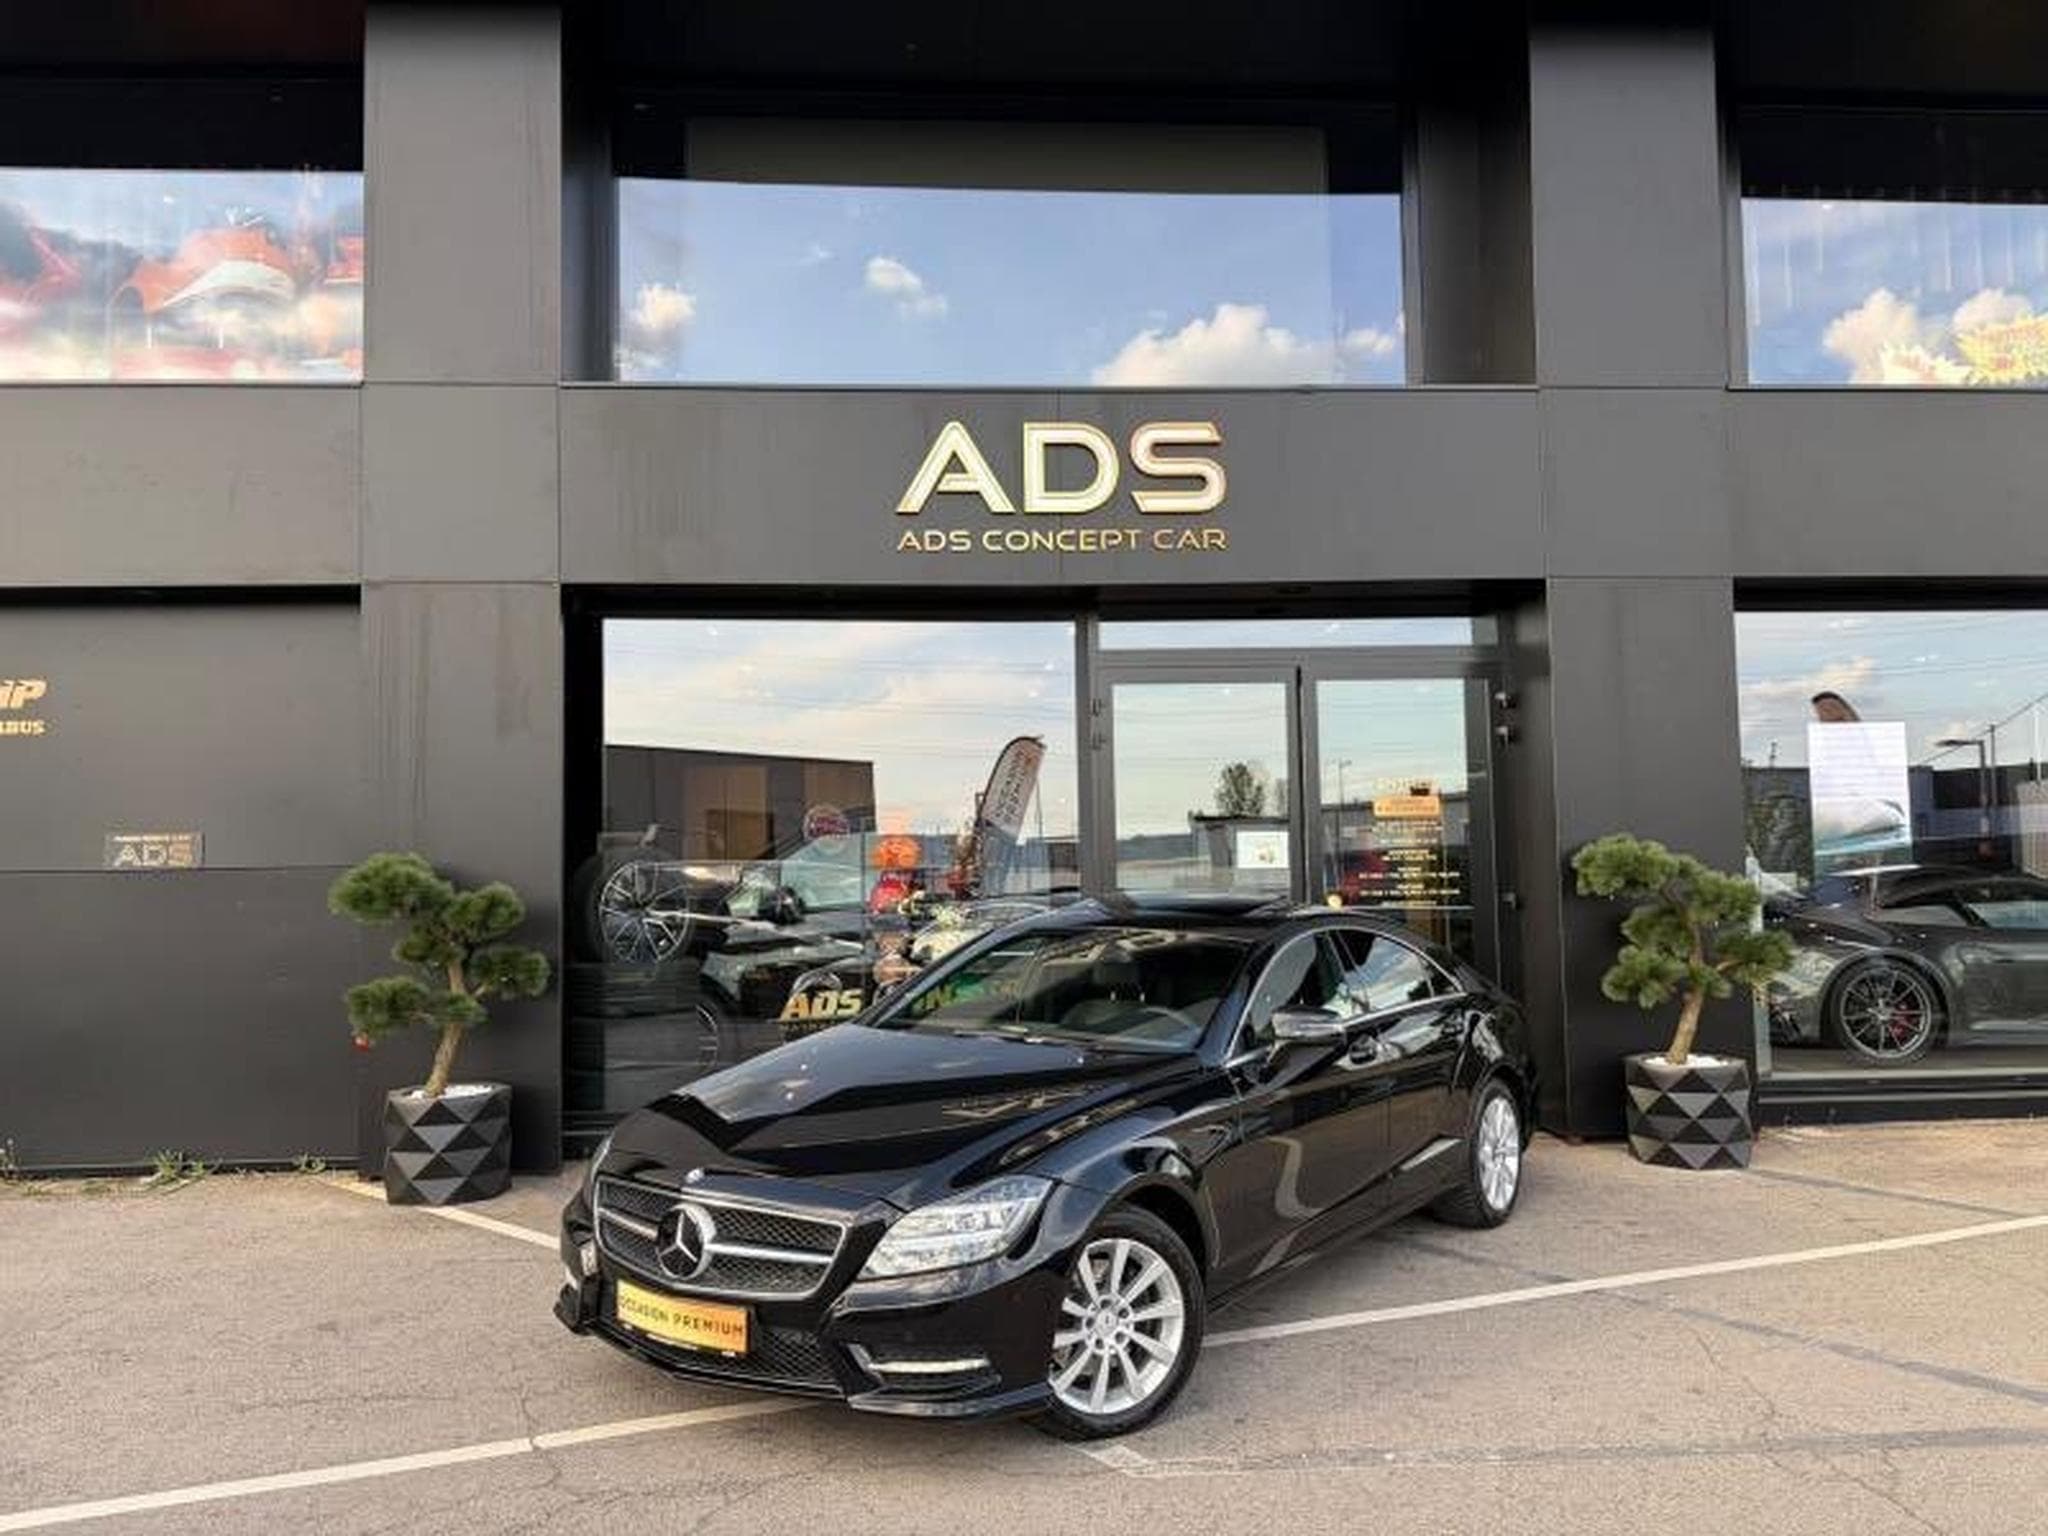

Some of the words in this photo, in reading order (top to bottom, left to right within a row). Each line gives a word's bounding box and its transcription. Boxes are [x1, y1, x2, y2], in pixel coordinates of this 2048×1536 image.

[896, 420, 1226, 514] ADS
[897, 530, 972, 551] ADS
[982, 529, 1140, 551] CONCEPT
[1153, 529, 1227, 550] CAR
[780, 990, 863, 1022] ADS
[673, 1312, 744, 1337] PREMIUM
